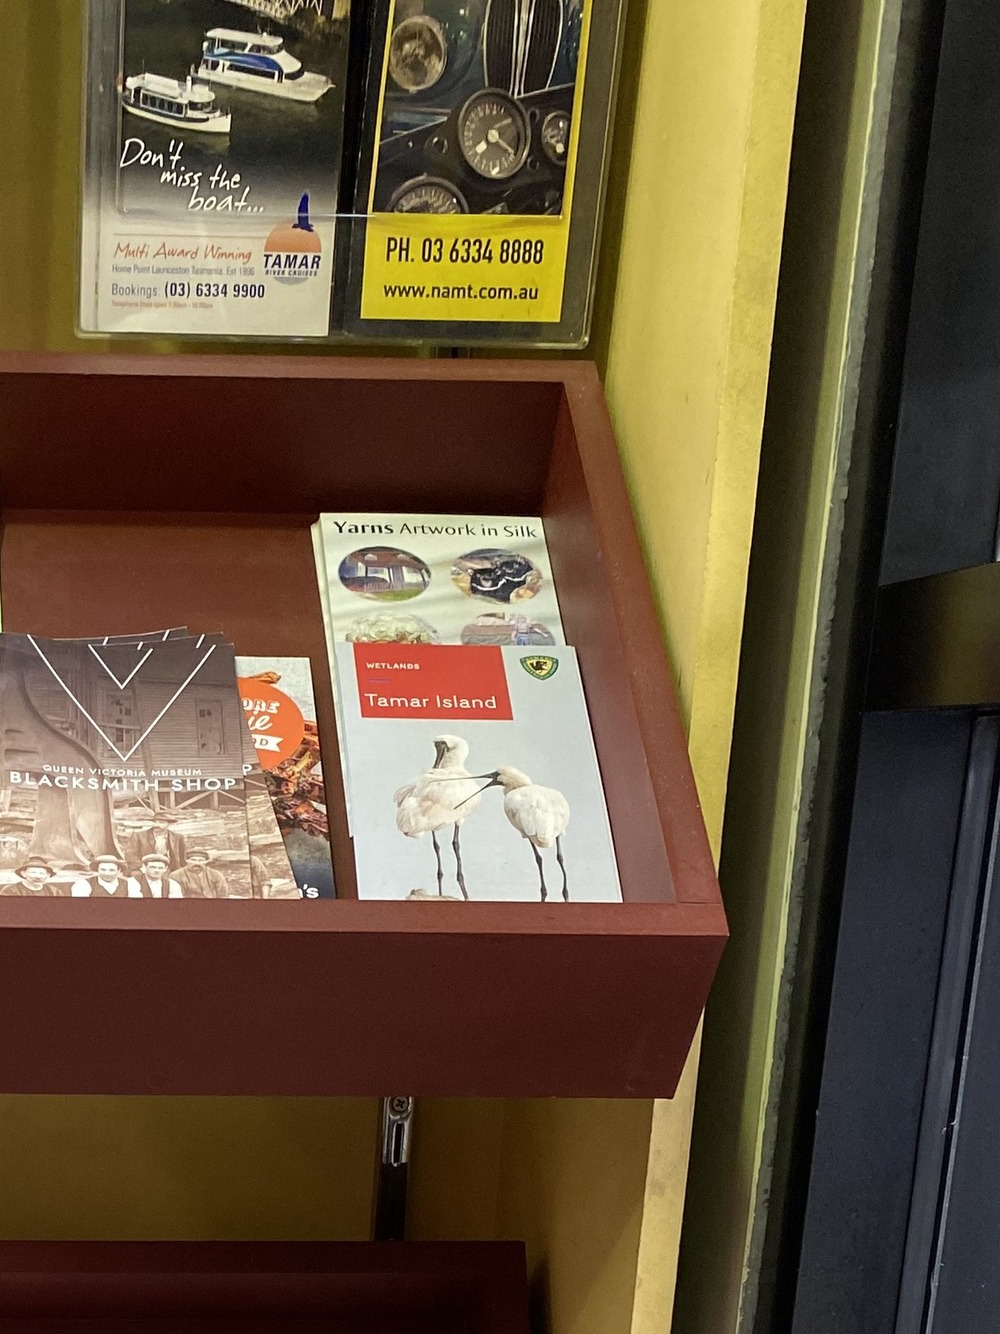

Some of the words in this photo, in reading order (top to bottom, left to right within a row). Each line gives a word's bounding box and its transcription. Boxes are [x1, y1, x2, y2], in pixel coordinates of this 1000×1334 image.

[120, 138, 184, 170] Don't
[160, 166, 203, 187] miss
[209, 163, 241, 191] the
[187, 186, 264, 212] boat...
[113, 242, 149, 260] Multi
[153, 241, 199, 260] Award
[203, 243, 252, 265] Winning
[386, 237, 415, 262] PH.
[421, 237, 443, 263] 03
[449, 238, 493, 264] 6334
[500, 239, 544, 264] 8888
[152, 265, 189, 275] Launceston
[263, 254, 321, 270] TAMAR
[164, 282, 191, 298] (03)
[196, 283, 228, 298] 6334
[233, 284, 265, 298] 9900
[383, 284, 539, 300] www.namt.com.au
[333, 521, 394, 534] Yarns
[399, 522, 477, 536] Artwork
[481, 524, 498, 537] in
[503, 525, 537, 538] Silk
[366, 662, 420, 670] WETLANDS
[364, 693, 430, 708] Tamar
[436, 695, 497, 709] Island
[42, 764, 84, 775] QUEEN
[89, 768, 147, 777] VICTORIA
[151, 768, 202, 777] MUSEUM
[9, 771, 159, 791] BLACKSMITH
[171, 778, 237, 792] SHOP
